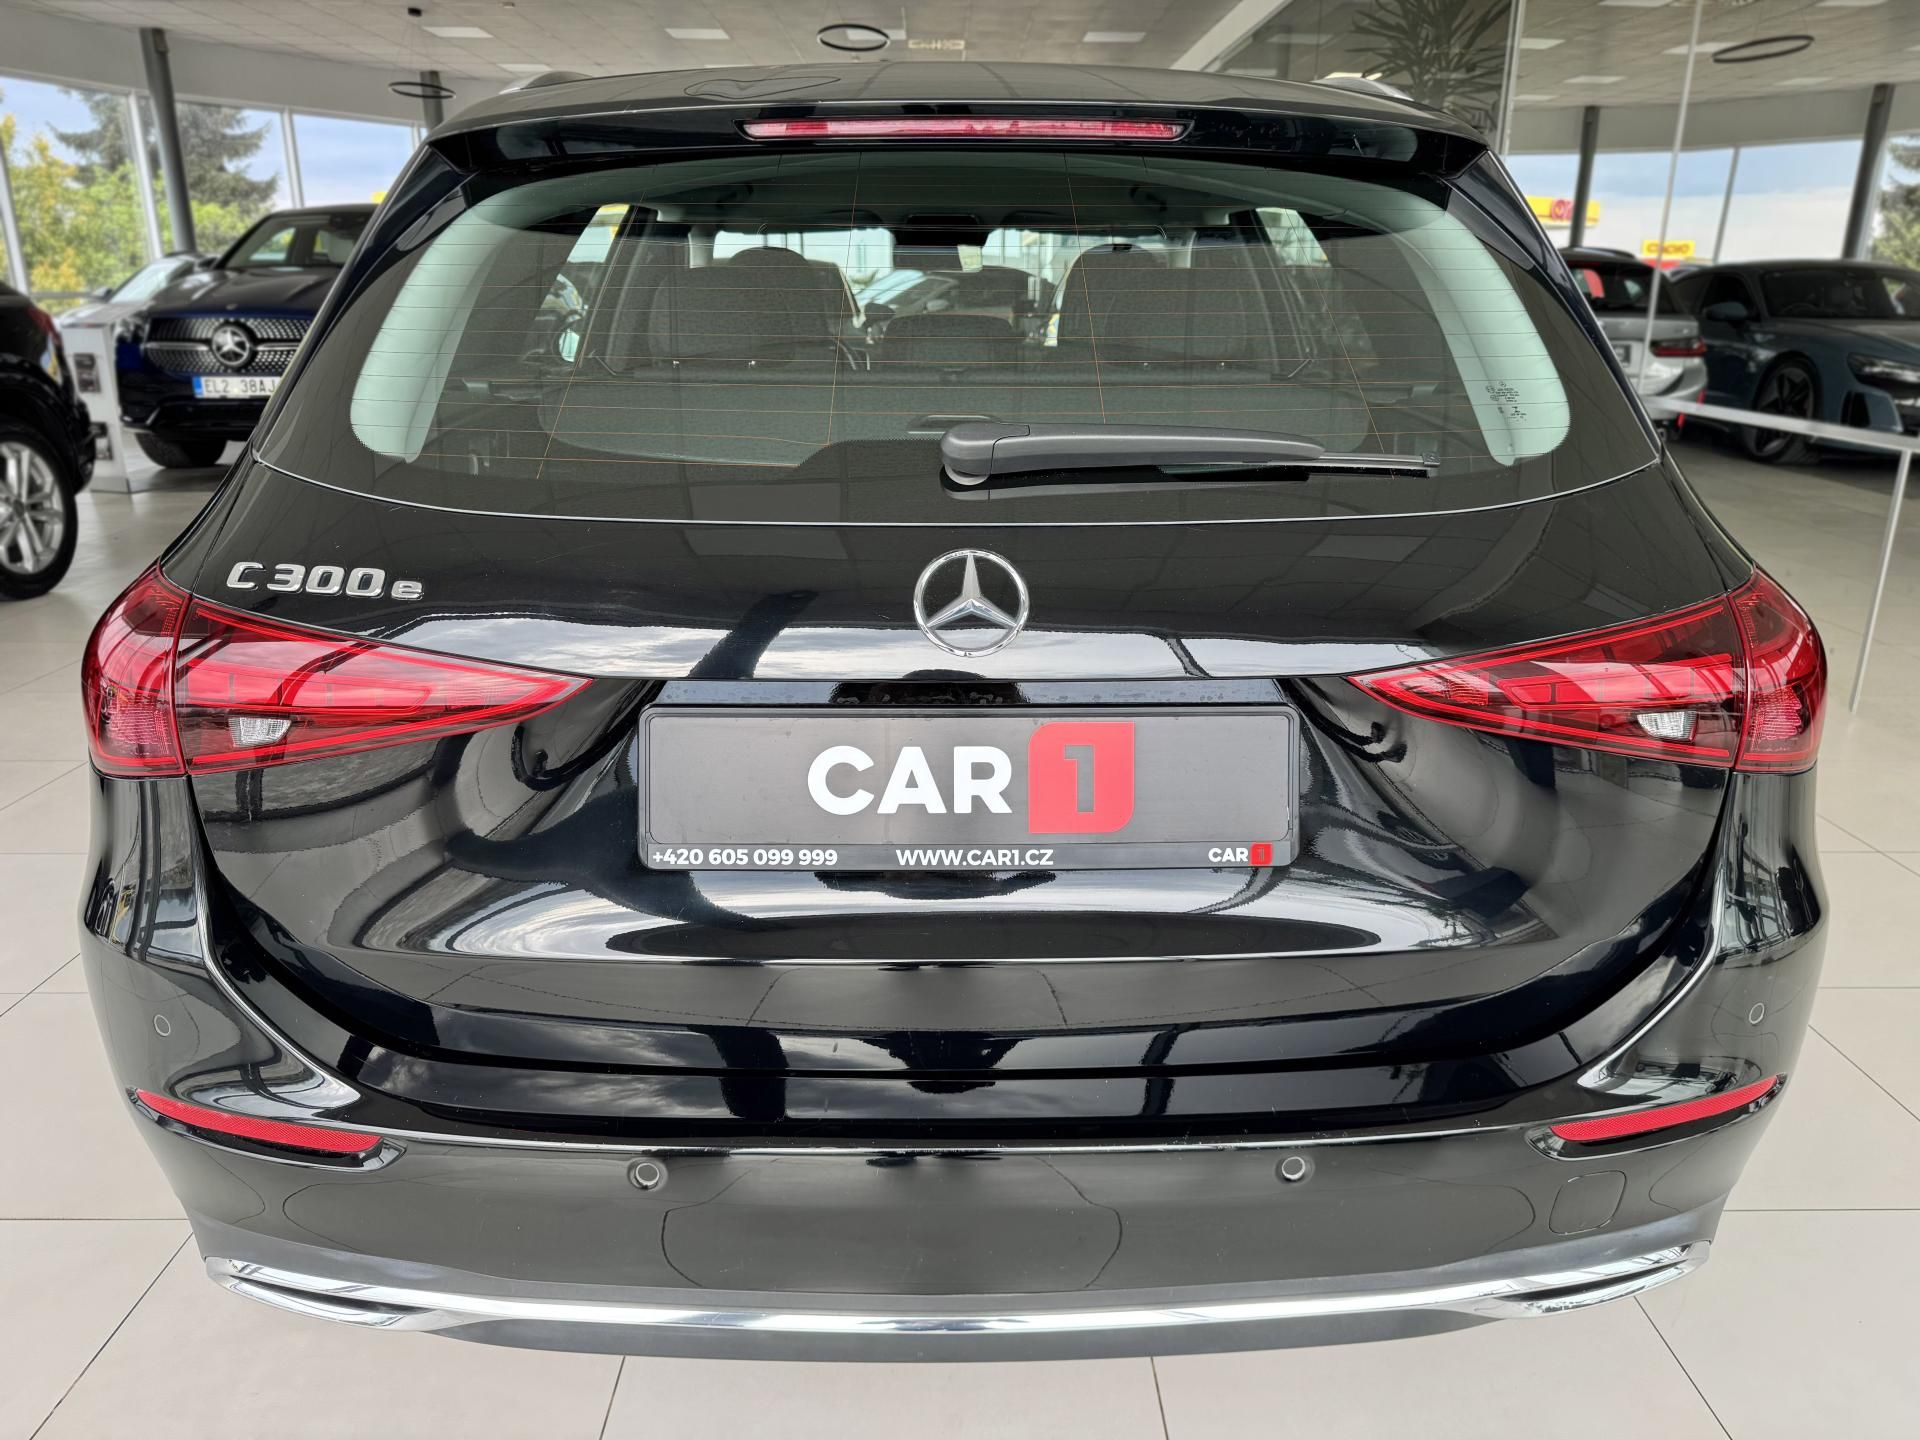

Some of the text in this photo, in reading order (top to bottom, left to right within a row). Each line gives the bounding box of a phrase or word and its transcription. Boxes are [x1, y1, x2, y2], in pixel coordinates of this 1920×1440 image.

[652, 849, 838, 865] +420 605 099 999
[895, 849, 1054, 866] WWW.CAR1.CZ
